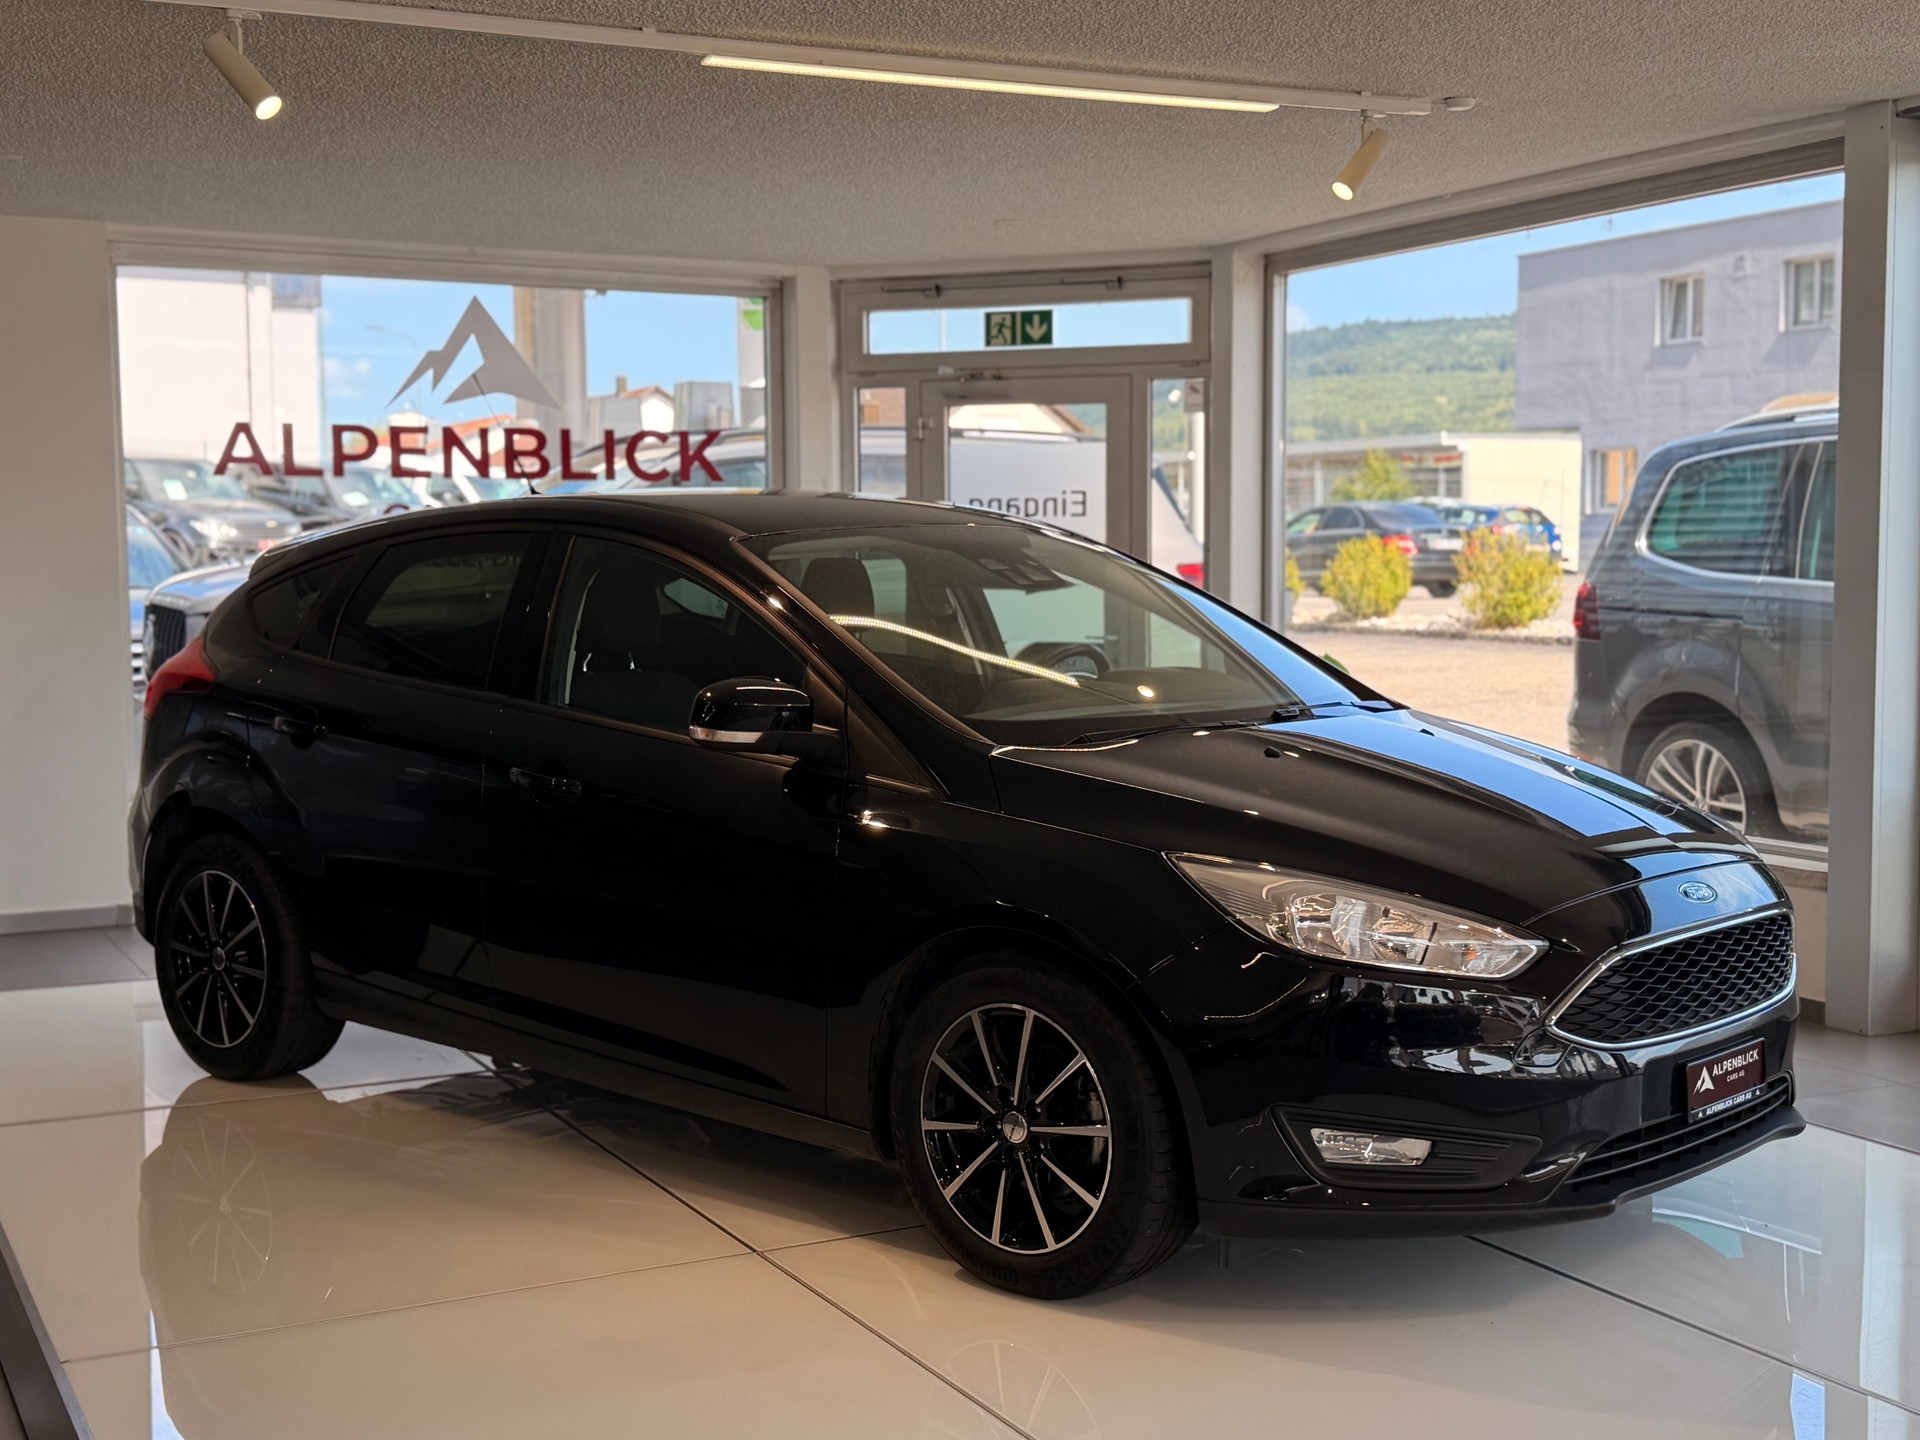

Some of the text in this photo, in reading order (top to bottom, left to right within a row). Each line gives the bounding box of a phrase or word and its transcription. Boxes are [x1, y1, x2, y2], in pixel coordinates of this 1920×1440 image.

[214, 422, 724, 482] ALPENBLICK
[1687, 886, 1709, 899] Ford
[1712, 1048, 1759, 1077] ALPENBLICK
[1727, 1073, 1739, 1082] CARS
[1706, 1091, 1752, 1115] ALPENBLICK CARS AG
